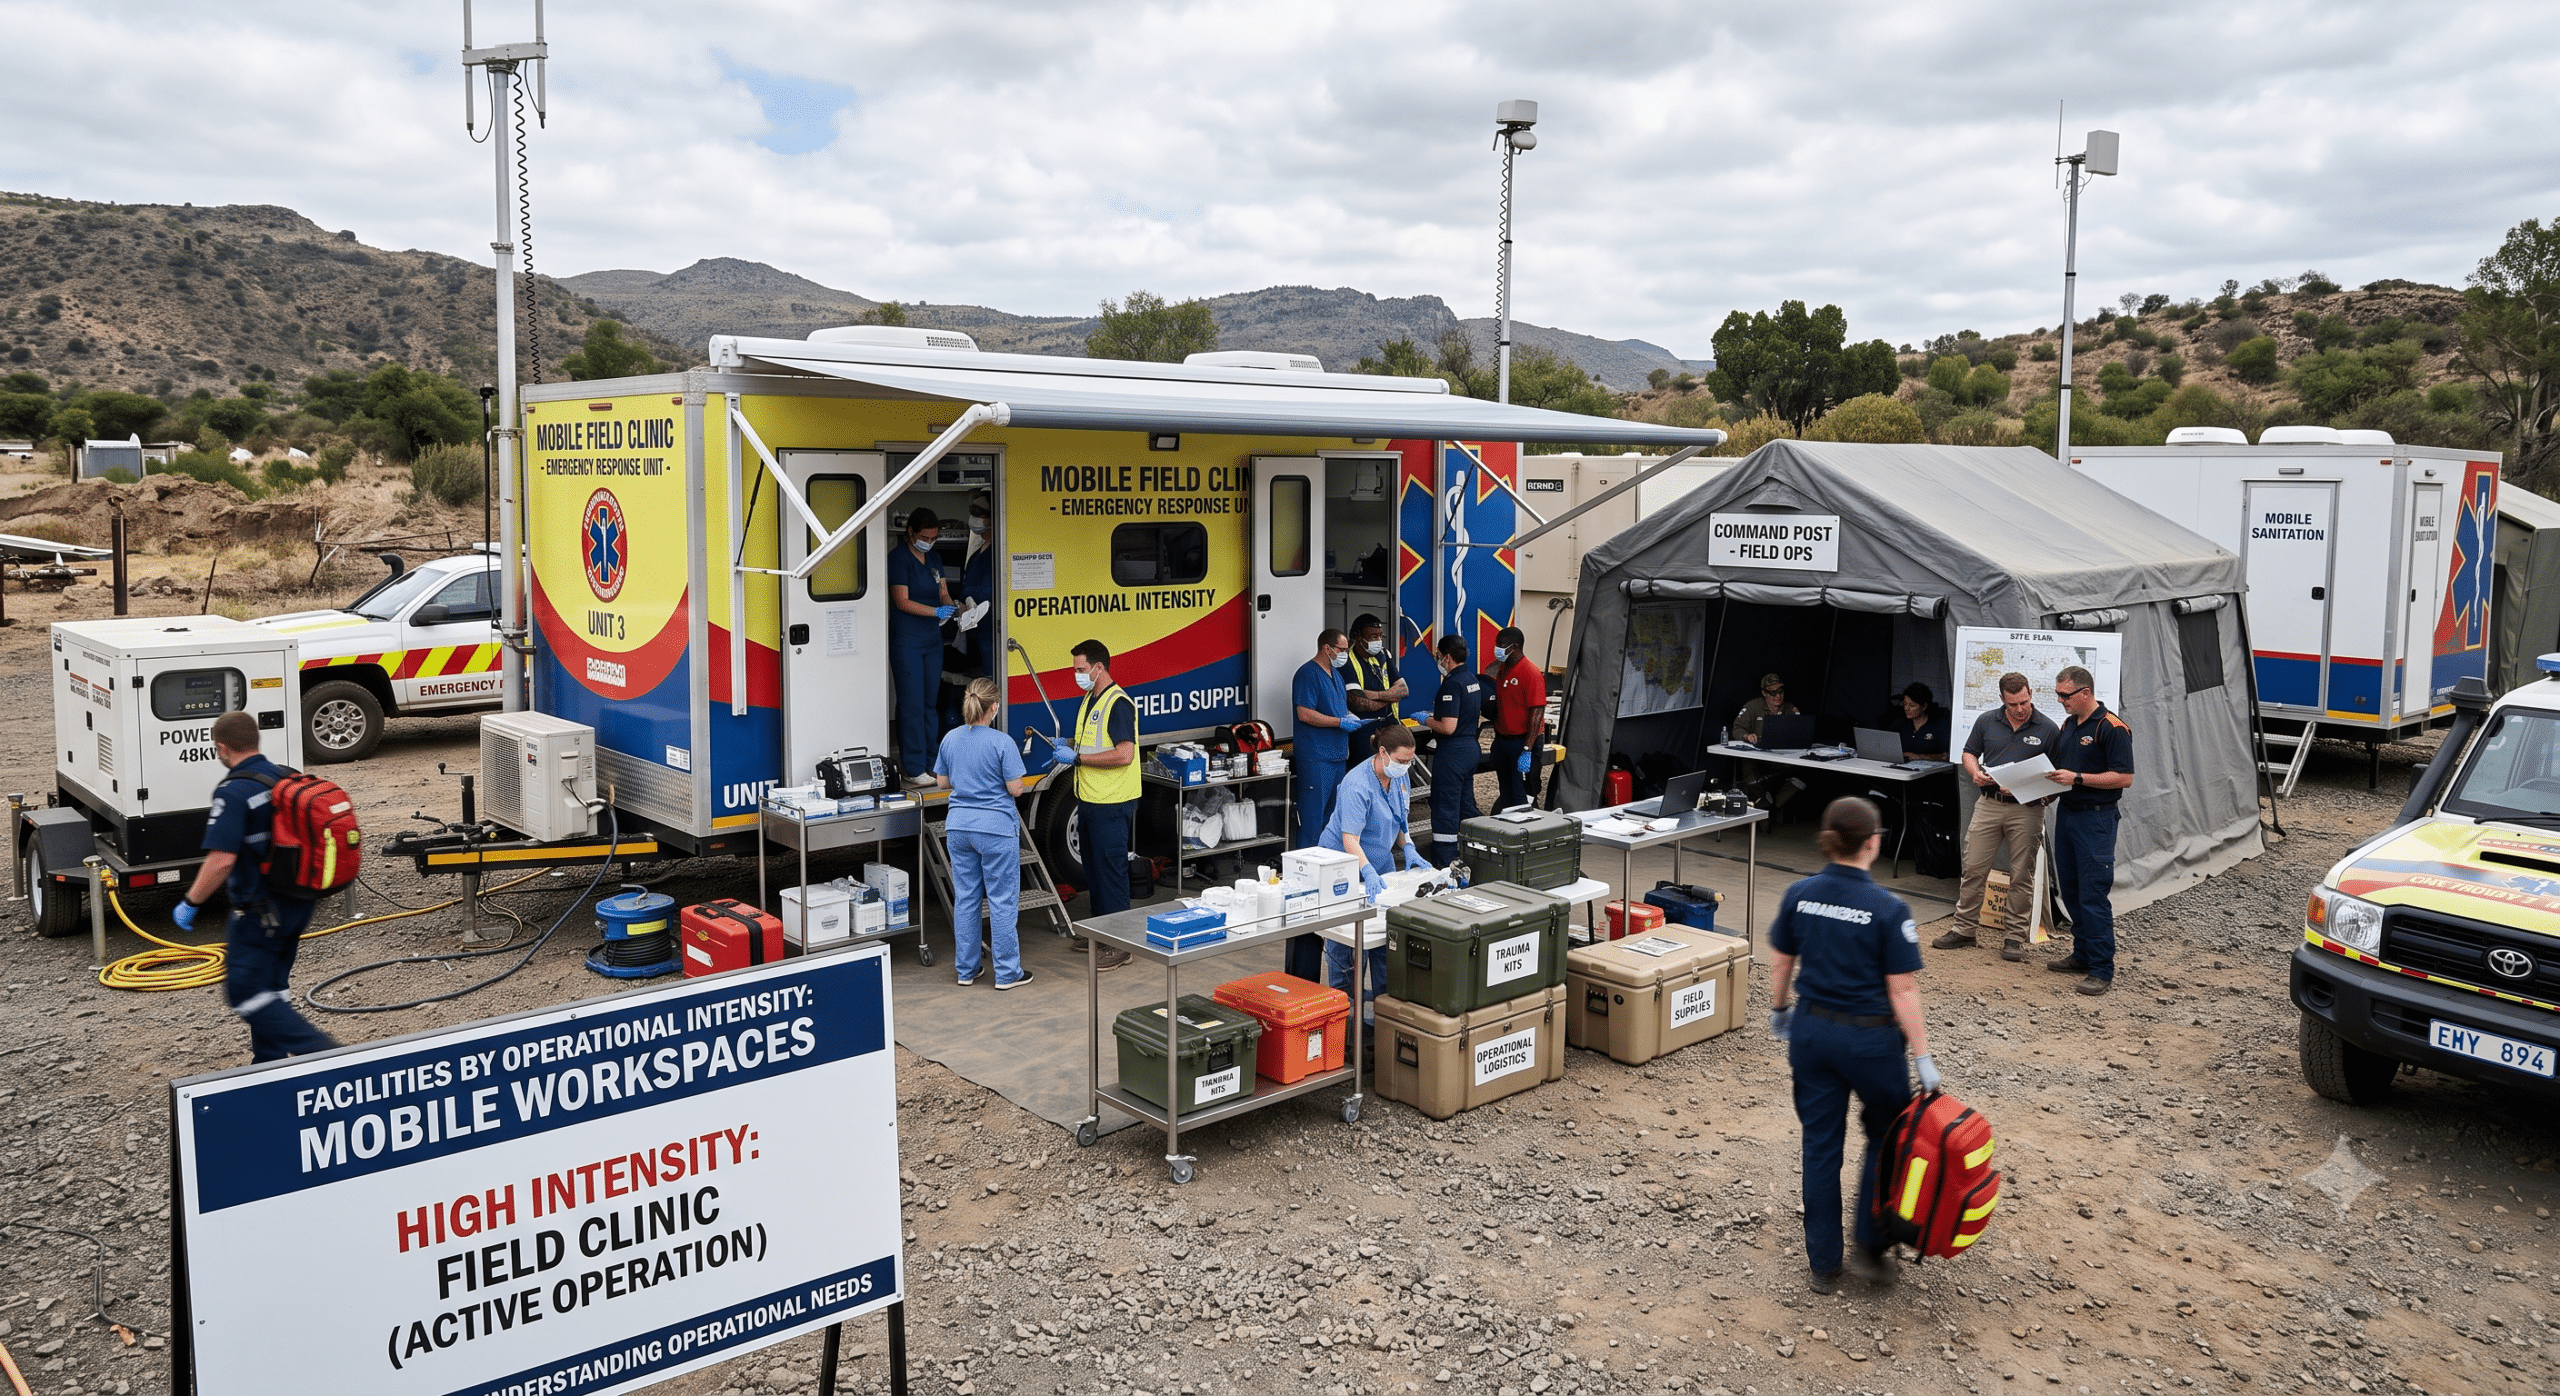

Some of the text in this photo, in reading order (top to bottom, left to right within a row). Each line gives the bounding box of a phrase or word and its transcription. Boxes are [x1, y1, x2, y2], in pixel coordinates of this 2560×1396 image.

[537, 418, 674, 451] MOBILE FIELD CLINIC
[546, 458, 594, 475] EMERGENCY
[596, 458, 640, 475] RESPONSE
[643, 458, 664, 475] UNIT
[1041, 466, 1250, 492] MOBILE FIELD CLIN
[1061, 498, 1153, 515] EMERGENCY
[1158, 498, 1230, 514] RESPONSE
[1234, 497, 1250, 514] UN
[2265, 513, 2312, 525] MOBILE
[1714, 523, 1833, 541] COMMAND POST
[2251, 528, 2324, 541] SANITATION
[1740, 544, 1779, 560] FIELD
[1784, 545, 1813, 561] OPS
[1014, 589, 1216, 618] OPERATIONAL INTENSITY
[588, 610, 625, 640] UNIT 3
[420, 680, 495, 696] EMERGENCY
[1134, 684, 1249, 716] FIELD SUPPLI
[723, 779, 779, 808] UNIT
[1496, 942, 1530, 960] TRAUMA
[1504, 959, 1523, 973] KITS
[1674, 1000, 1711, 1021] SUPPLIES
[1683, 990, 1704, 1005] FIELD
[297, 984, 814, 1117] FACILITIES BY OPERATIONAL INTENSITY:
[1477, 1037, 1533, 1064] OPERATIONAL
[1484, 1052, 1526, 1075] LOGISTICS
[2501, 1042, 2544, 1071] 894
[300, 1016, 816, 1173] MOBILE WORKSPACES
[397, 1123, 760, 1254] HIGH INTENSITY:
[437, 1185, 720, 1301] FIELD CLINIC
[387, 1222, 767, 1370] (ACTIVE OPERATION)
[667, 1294, 807, 1355] OPERATIONAL
[811, 1272, 873, 1309] NEEDS
